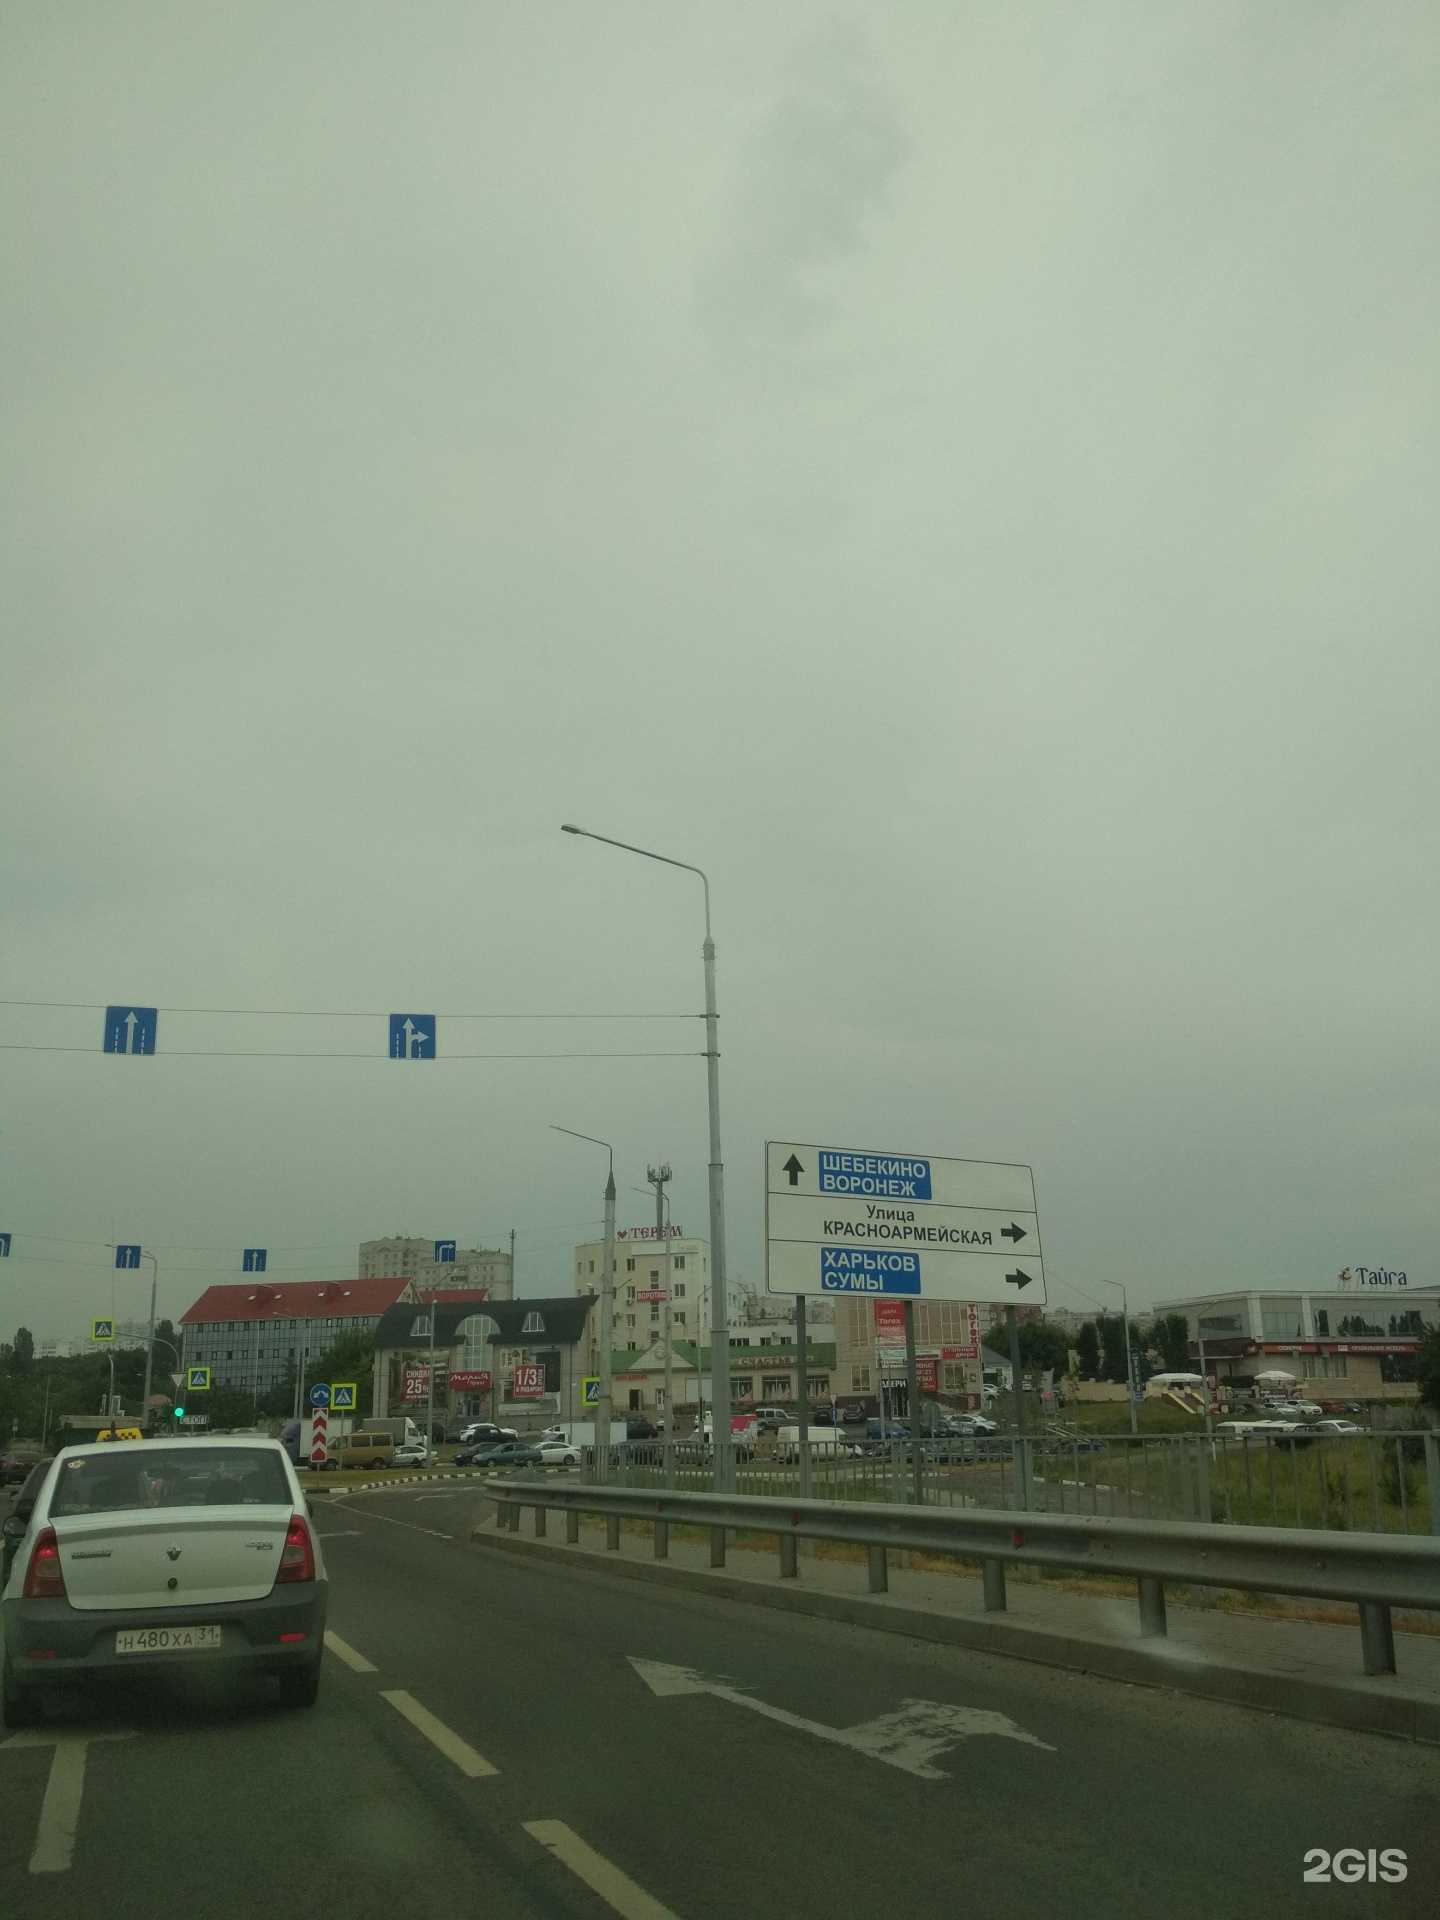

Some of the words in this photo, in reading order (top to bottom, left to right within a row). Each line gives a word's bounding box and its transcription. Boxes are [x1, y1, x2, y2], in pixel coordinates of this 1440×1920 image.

[823, 1155, 926, 1178] ШЕБЕКИНО
[823, 1175, 916, 1197] ВОРОНЕЖ
[867, 1204, 915, 1223] Улица
[823, 1220, 993, 1246] КРАСНОАРМЕЙСКАЯ
[824, 1251, 916, 1272] ХАРЬКОВ
[824, 1271, 884, 1291] СУМЫ
[1355, 1266, 1407, 1286] Тайга
[516, 1367, 538, 1386] 1/3
[123, 1630, 193, 1649] Н480ХА
[198, 1627, 216, 1641] 31
